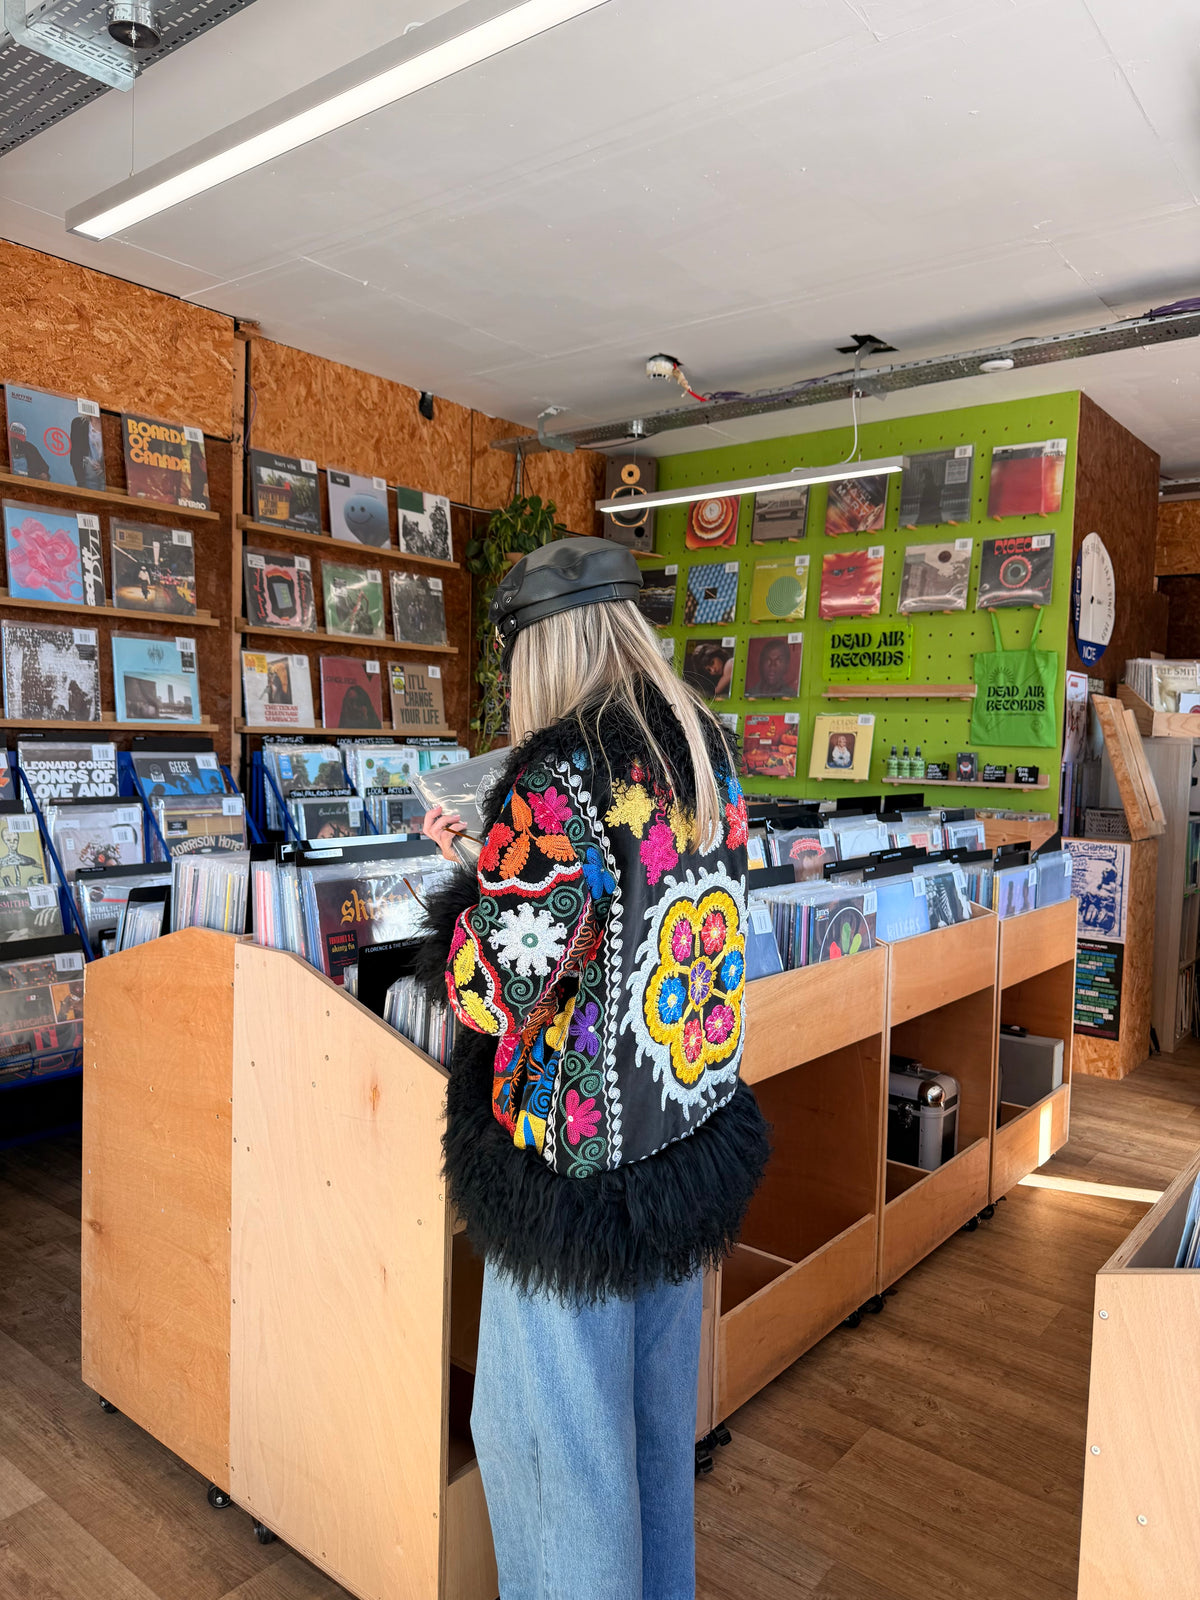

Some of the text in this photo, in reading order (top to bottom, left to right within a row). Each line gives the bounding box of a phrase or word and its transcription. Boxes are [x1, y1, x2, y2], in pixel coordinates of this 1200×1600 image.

[127, 419, 188, 446] BOARDS
[128, 434, 151, 452] OF
[130, 448, 192, 474] CANADA
[994, 537, 1041, 556] PIGEO
[831, 631, 905, 650] DEAD AIR
[830, 650, 904, 668] RECORDS
[1174, 667, 1196, 676] SMIT
[404, 691, 434, 708] CHANGE
[987, 685, 1045, 699] DEAD AIR
[986, 699, 1045, 712] RECORDS
[400, 708, 440, 725] YOUR LIFE
[24, 760, 116, 770] LEONARD COHEN
[168, 760, 192, 774] GEESE
[26, 769, 116, 785] SONGS OF
[77, 782, 117, 798] AND
[367, 788, 386, 796] LOCAL
[765, 820, 775, 831] K
